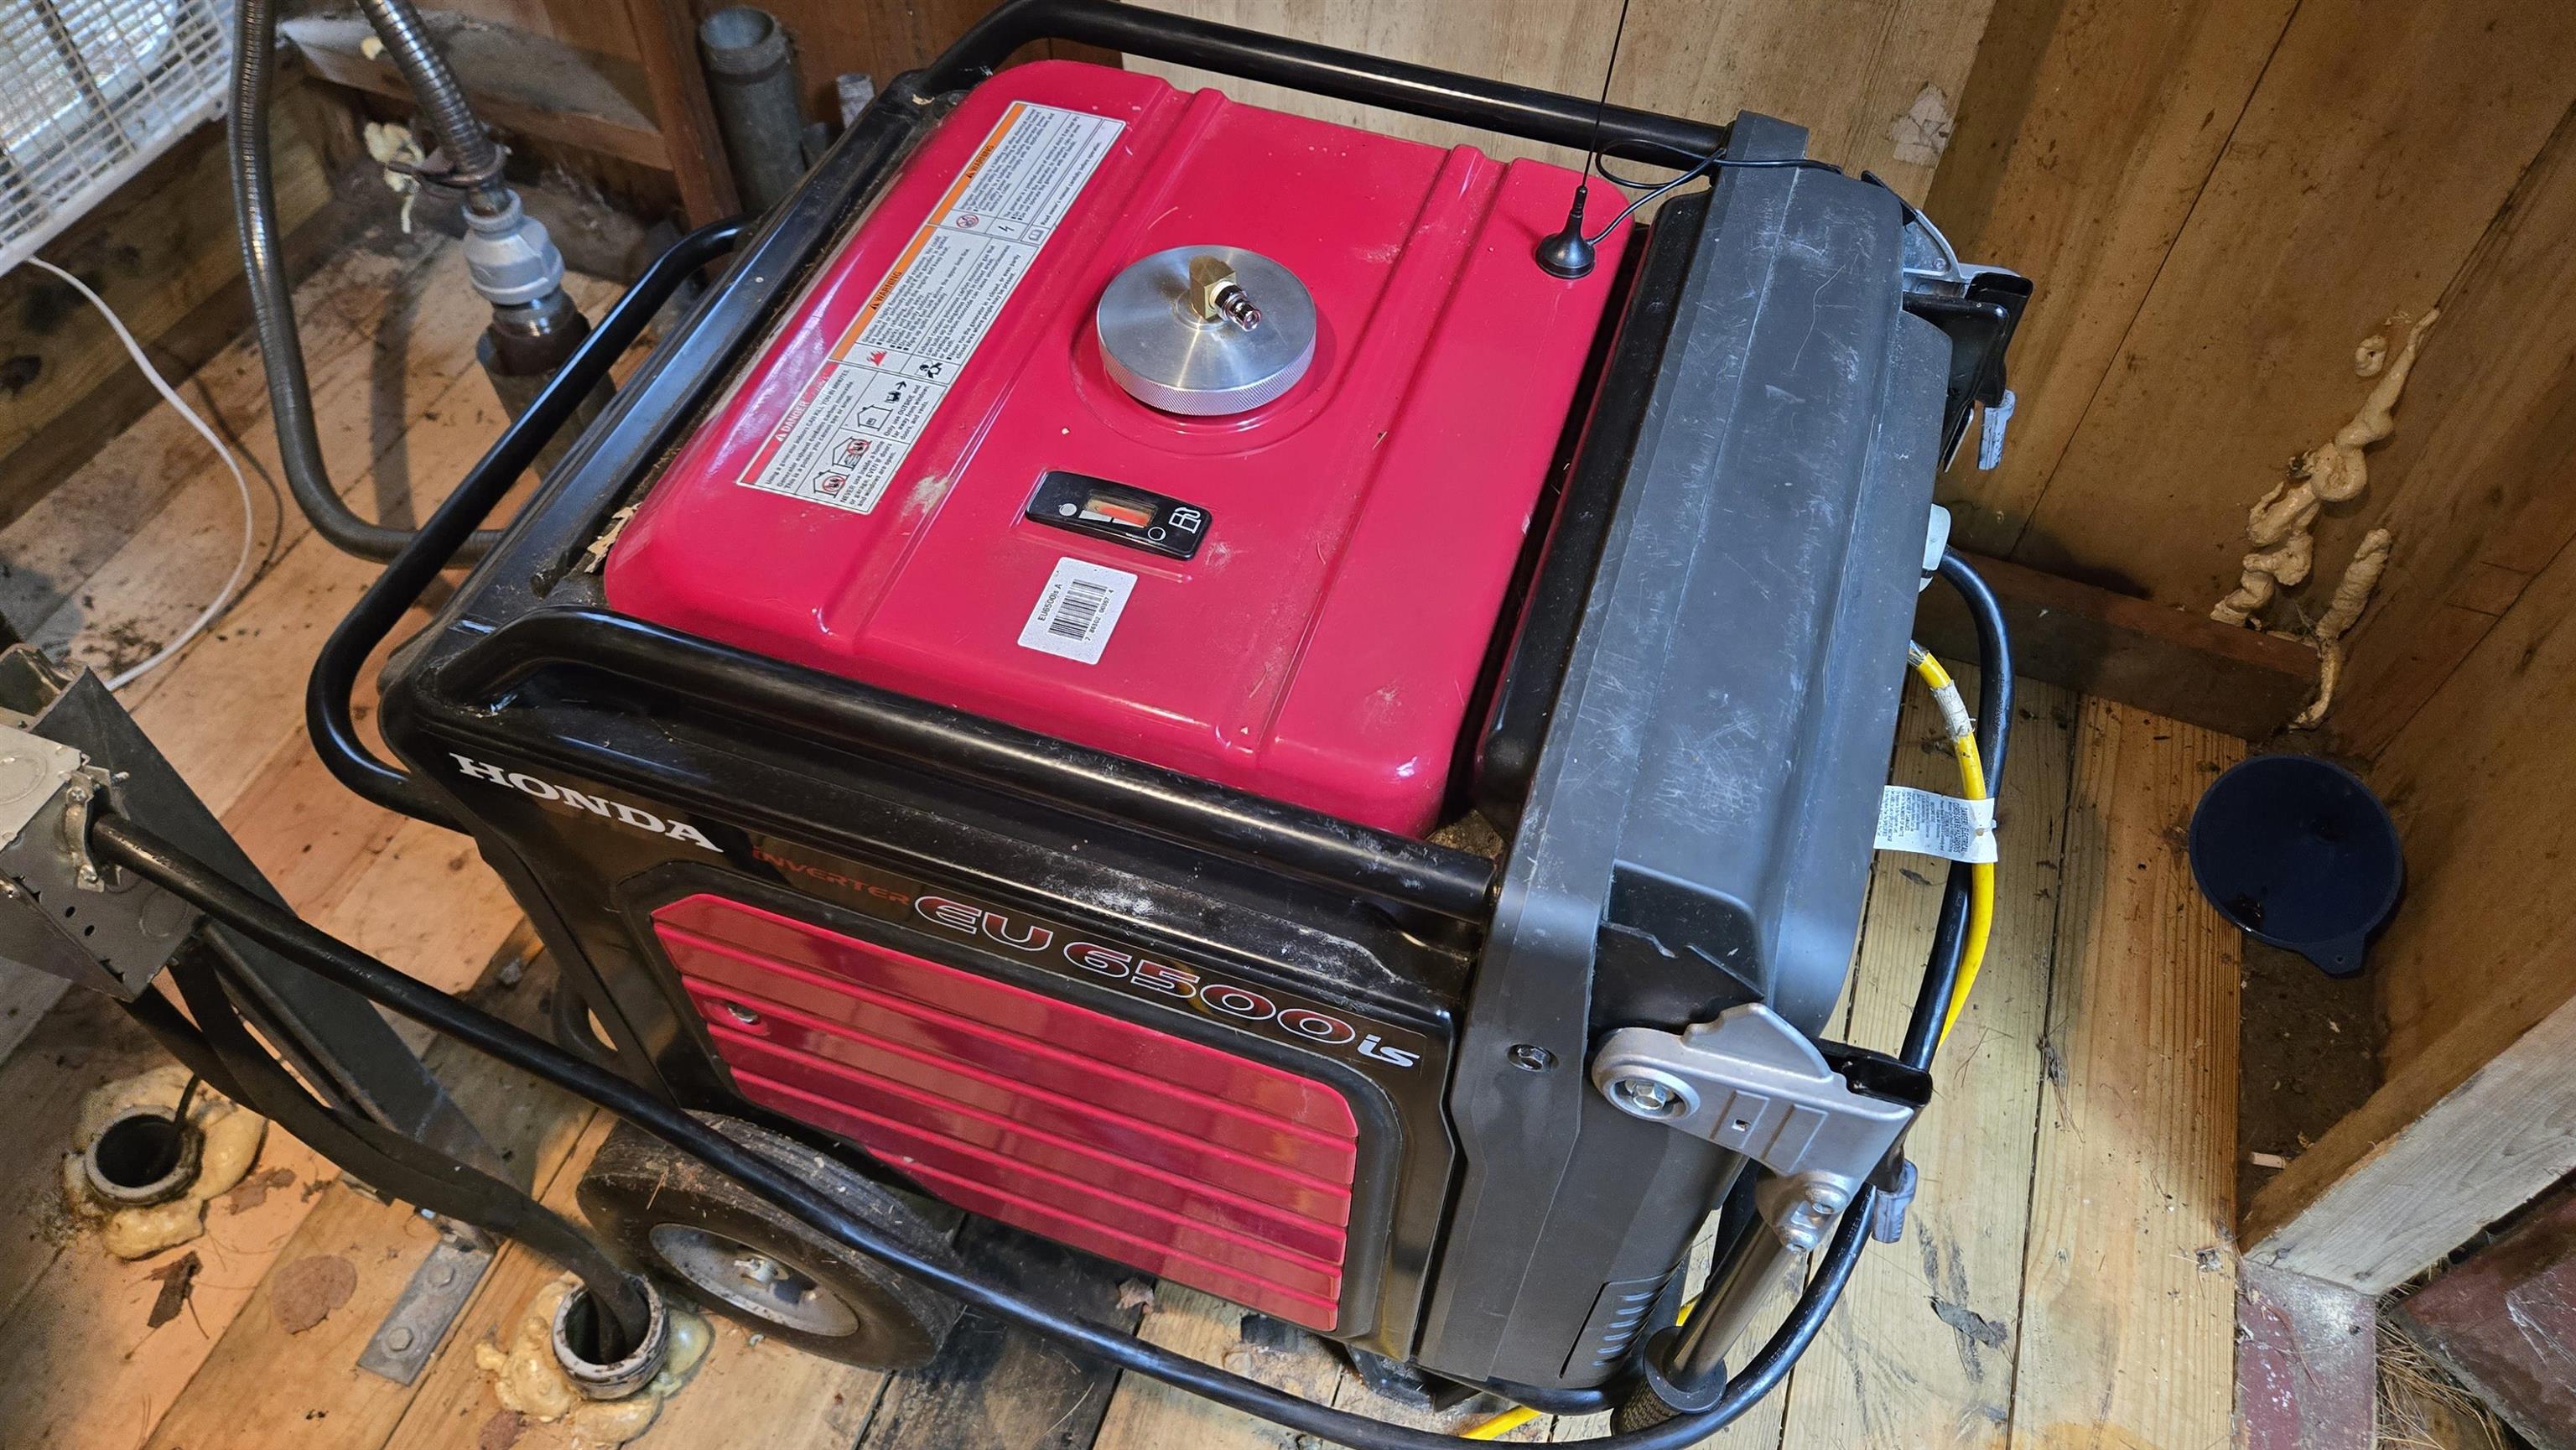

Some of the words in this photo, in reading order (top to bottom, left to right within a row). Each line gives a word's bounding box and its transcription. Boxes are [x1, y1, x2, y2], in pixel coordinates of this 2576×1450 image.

[969, 144, 995, 171] WARNING
[873, 271, 902, 302] WARNING
[780, 400, 809, 432] DANGER
[882, 424, 896, 436] Only
[891, 415, 901, 424] use
[896, 394, 915, 415] OUTSIDE
[911, 384, 922, 393] and
[896, 418, 910, 429] away
[905, 405, 917, 417] from
[909, 414, 920, 424] and
[916, 400, 929, 413] vents.
[764, 470, 780, 485] Using
[776, 444, 798, 466] generator
[792, 426, 809, 443] indoors
[805, 415, 818, 426] CAN
[813, 406, 824, 416] KILL
[820, 395, 832, 405] YOU
[776, 461, 797, 486] Generator
[794, 441, 812, 460] exhaust
[808, 421, 826, 441] contains
[822, 403, 839, 421] carbon
[783, 477, 796, 489] This
[798, 450, 816, 467] poison
[811, 441, 823, 450] you
[818, 424, 834, 440] cannot
[830, 415, 839, 424] see
[865, 463, 880, 477] EVEN
[879, 443, 893, 457] doors
[839, 485, 855, 502] NEVER
[853, 475, 862, 484] use
[858, 459, 873, 474] inside
[871, 440, 885, 455] home
[855, 496, 866, 507] and
[862, 475, 880, 496] windows
[878, 465, 887, 475] are
[883, 450, 897, 465] open.
[1038, 590, 1059, 621] EU6500is
[1089, 616, 1101, 633] 86102
[1098, 597, 1110, 613] 00367
[449, 752, 724, 853] HONDA
[752, 848, 911, 906] INVERTER
